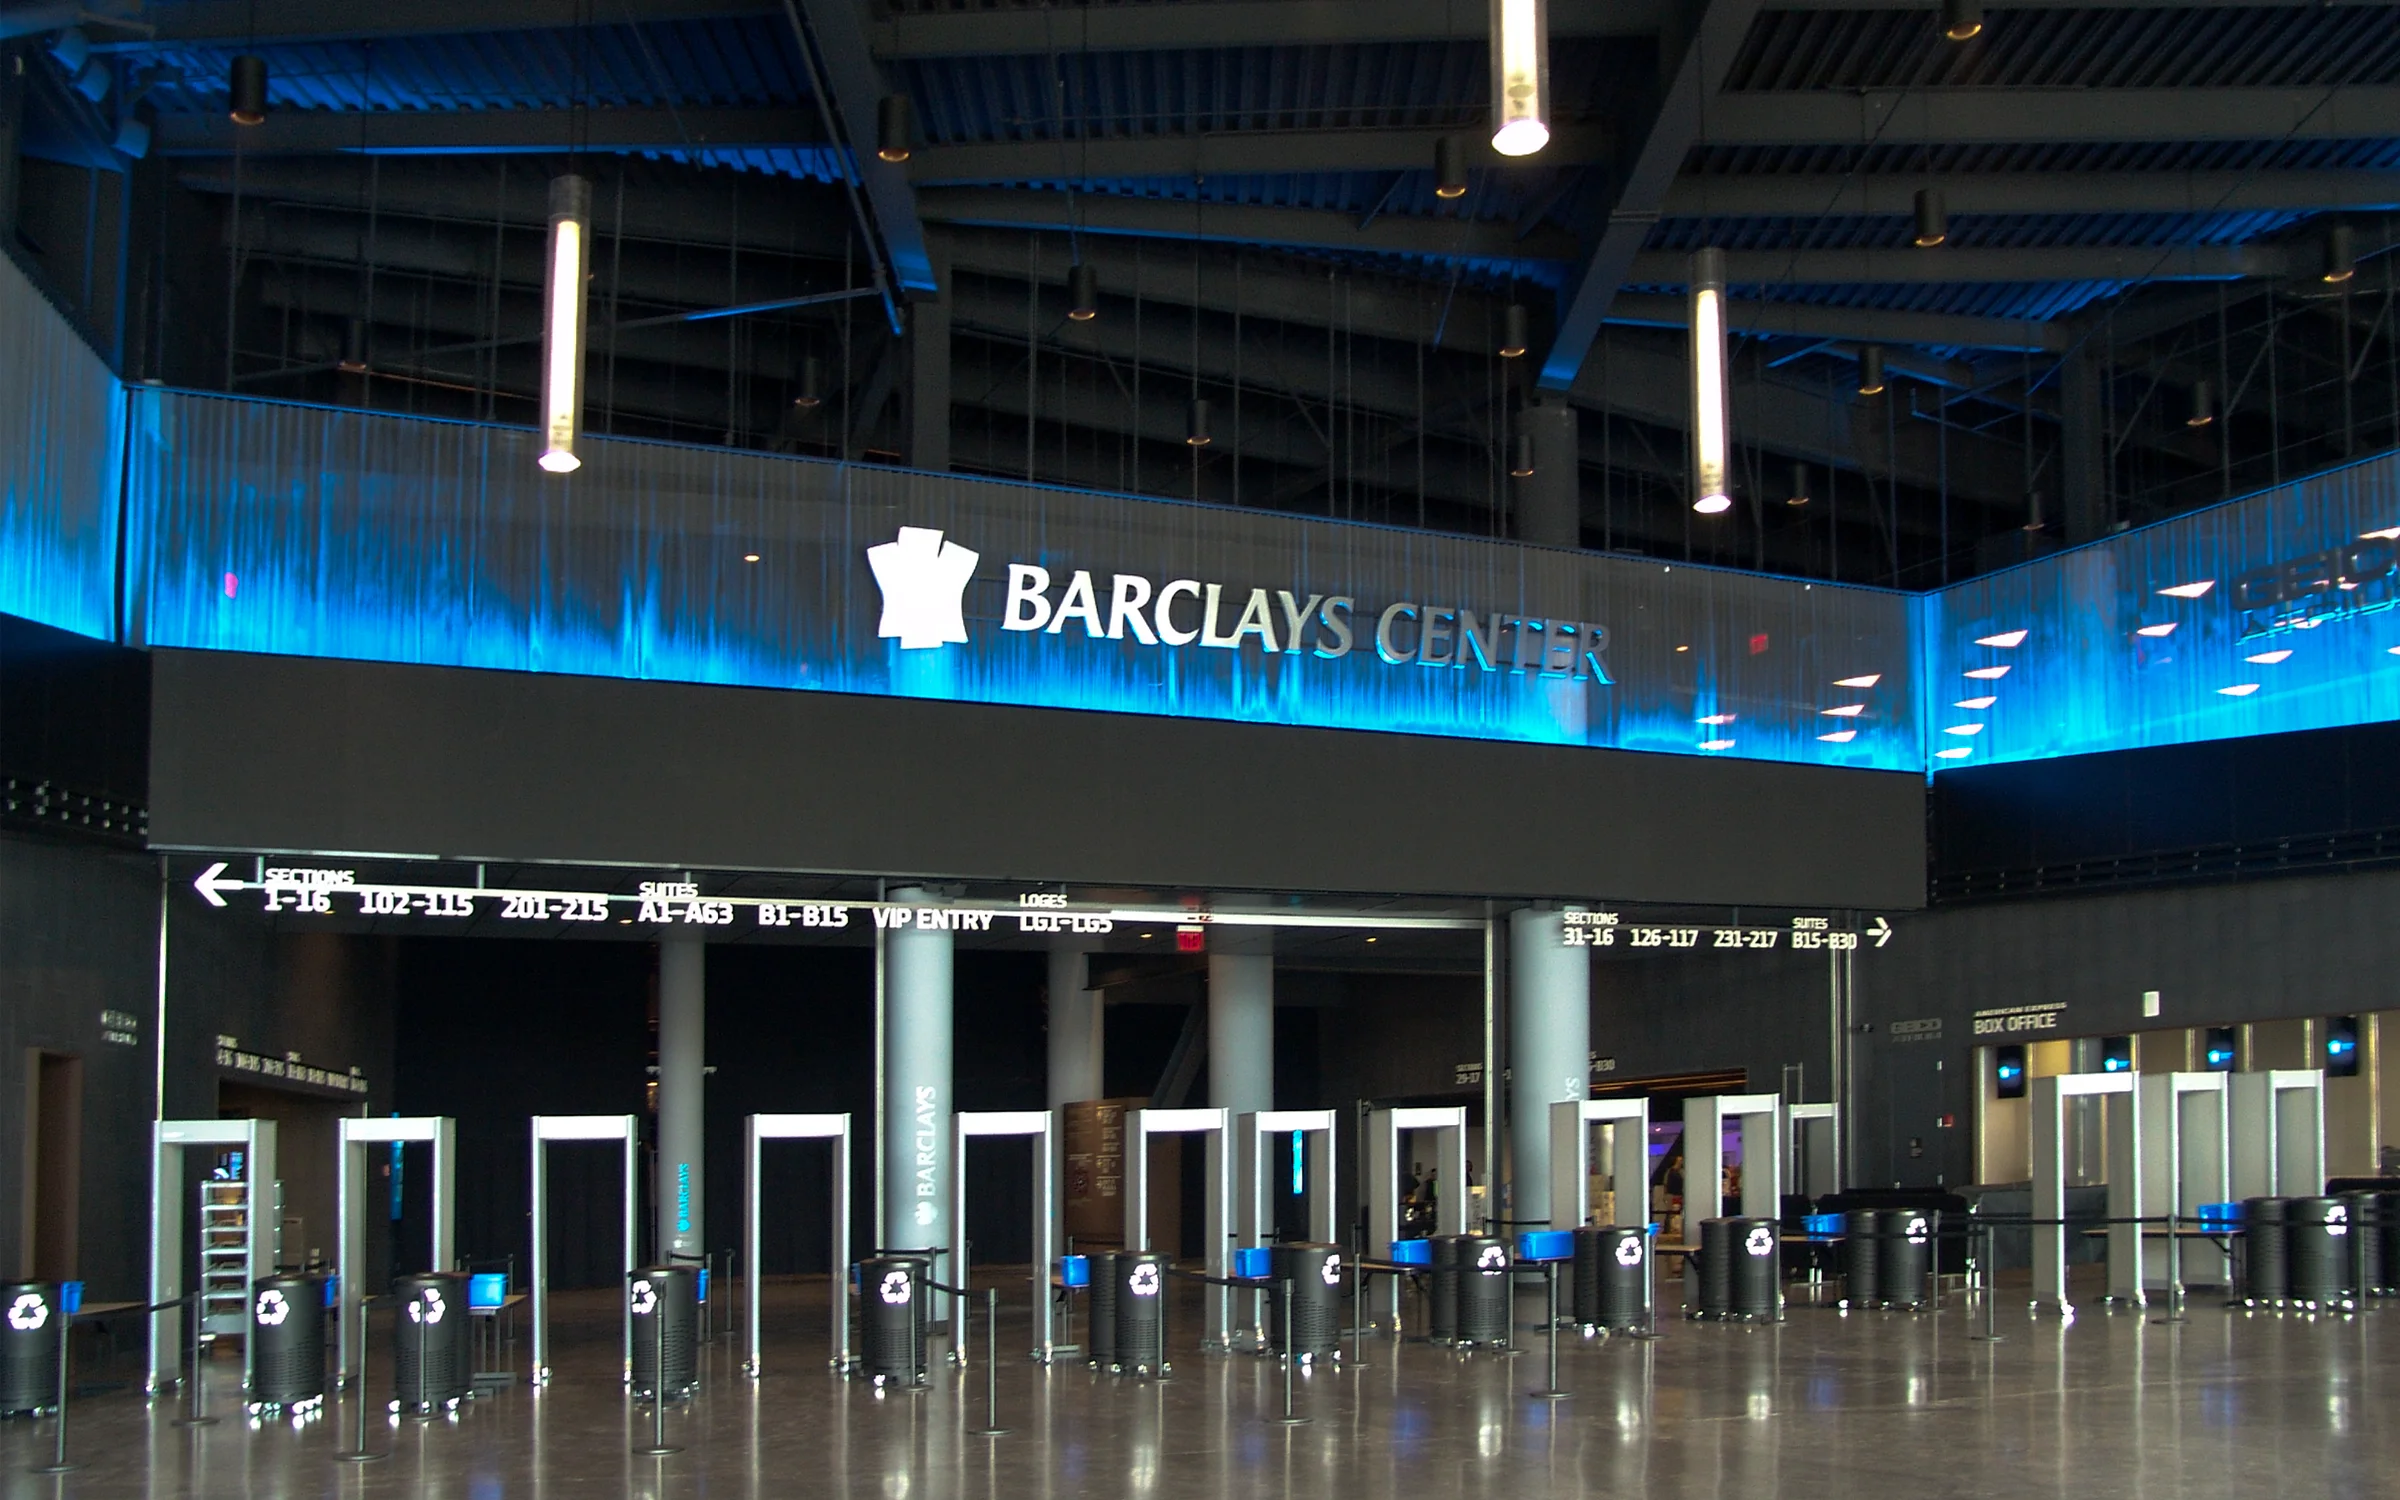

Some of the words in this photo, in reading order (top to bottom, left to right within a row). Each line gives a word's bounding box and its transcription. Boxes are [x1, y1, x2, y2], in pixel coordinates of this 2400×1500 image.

[2231, 535, 2400, 611] GEIC
[1001, 563, 1355, 659] BARCLAYS
[1375, 603, 1616, 685] CENTER
[265, 868, 355, 885] SECTIONS
[639, 882, 698, 899] SUITES
[1020, 893, 1067, 908] LOGES
[264, 885, 331, 912] 1-16
[360, 890, 474, 917] 102-115
[501, 896, 609, 921] 201-215
[638, 900, 734, 924] A1-A63
[758, 904, 848, 927] B1-B15
[872, 907, 911, 929] VIP
[916, 908, 996, 931] ENTRY
[1020, 912, 1113, 933] LG1-LG5
[1563, 912, 1619, 925] SECTIONS
[1792, 917, 1828, 929] SUITES
[1563, 927, 1614, 946] 31-16
[1630, 928, 1699, 947] 126-117
[1713, 930, 1778, 948] 231-217
[1792, 932, 1857, 949] B15-B30
[1974, 1018, 2004, 1035] BOX
[2006, 1013, 2057, 1033] OFFICE
[916, 1086, 936, 1196] BARCLAYS
[678, 1163, 690, 1218] BARCLAYS
